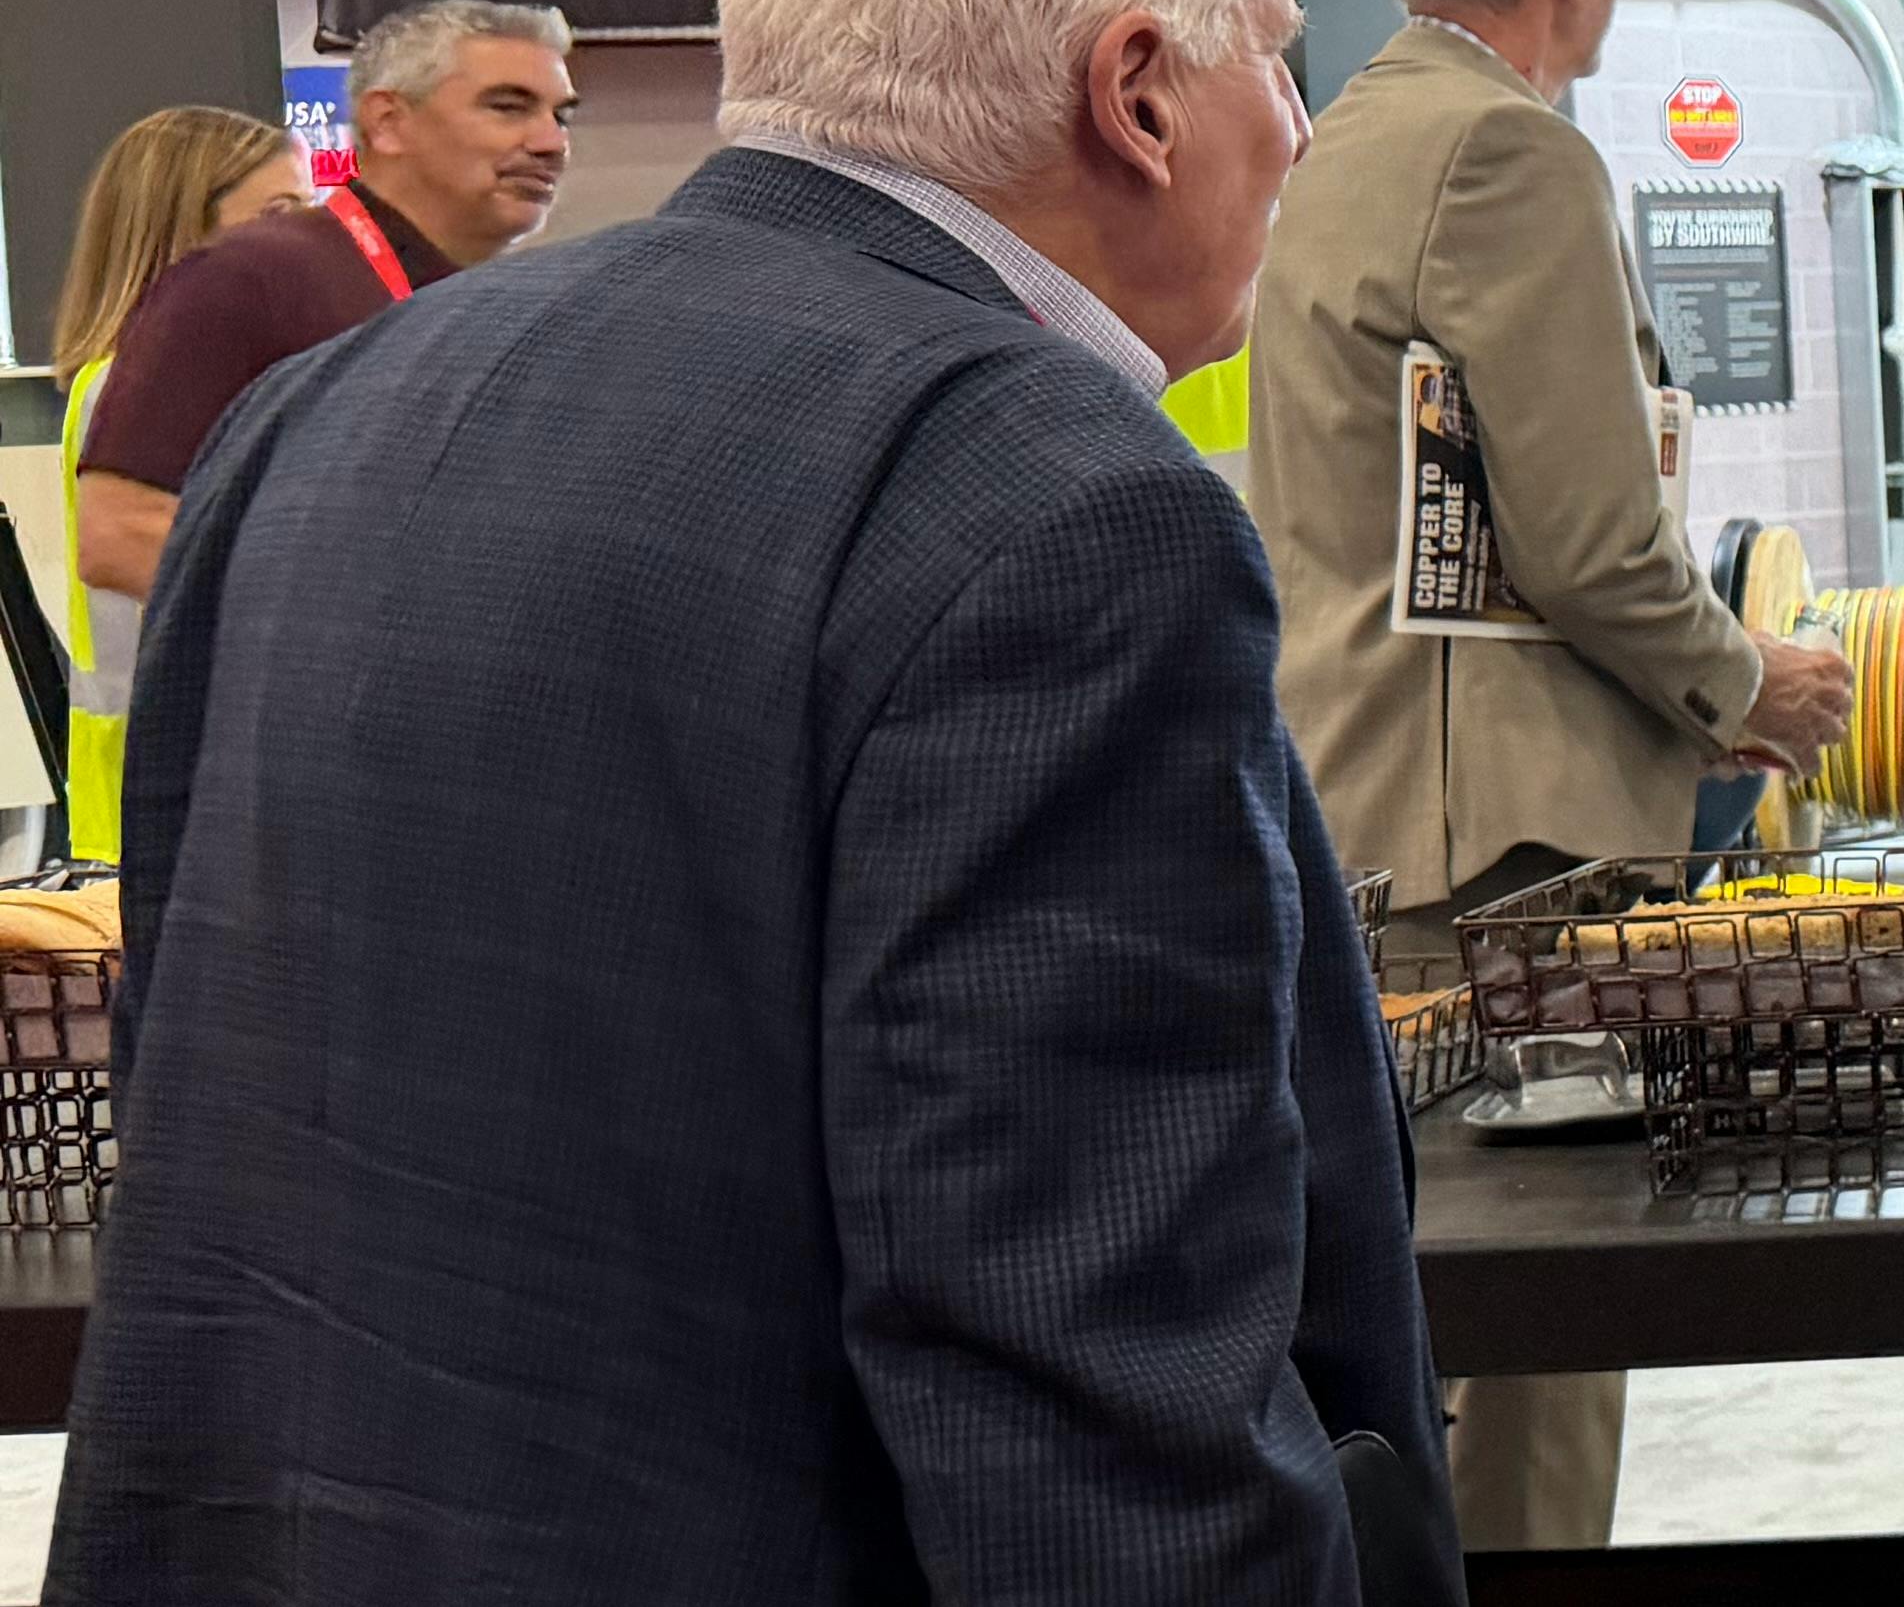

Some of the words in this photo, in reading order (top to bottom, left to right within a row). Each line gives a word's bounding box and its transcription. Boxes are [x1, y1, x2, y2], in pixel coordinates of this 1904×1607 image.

[1422, 463, 1441, 498] TO
[1415, 502, 1441, 609] COPPER
[1437, 560, 1460, 610] THE
